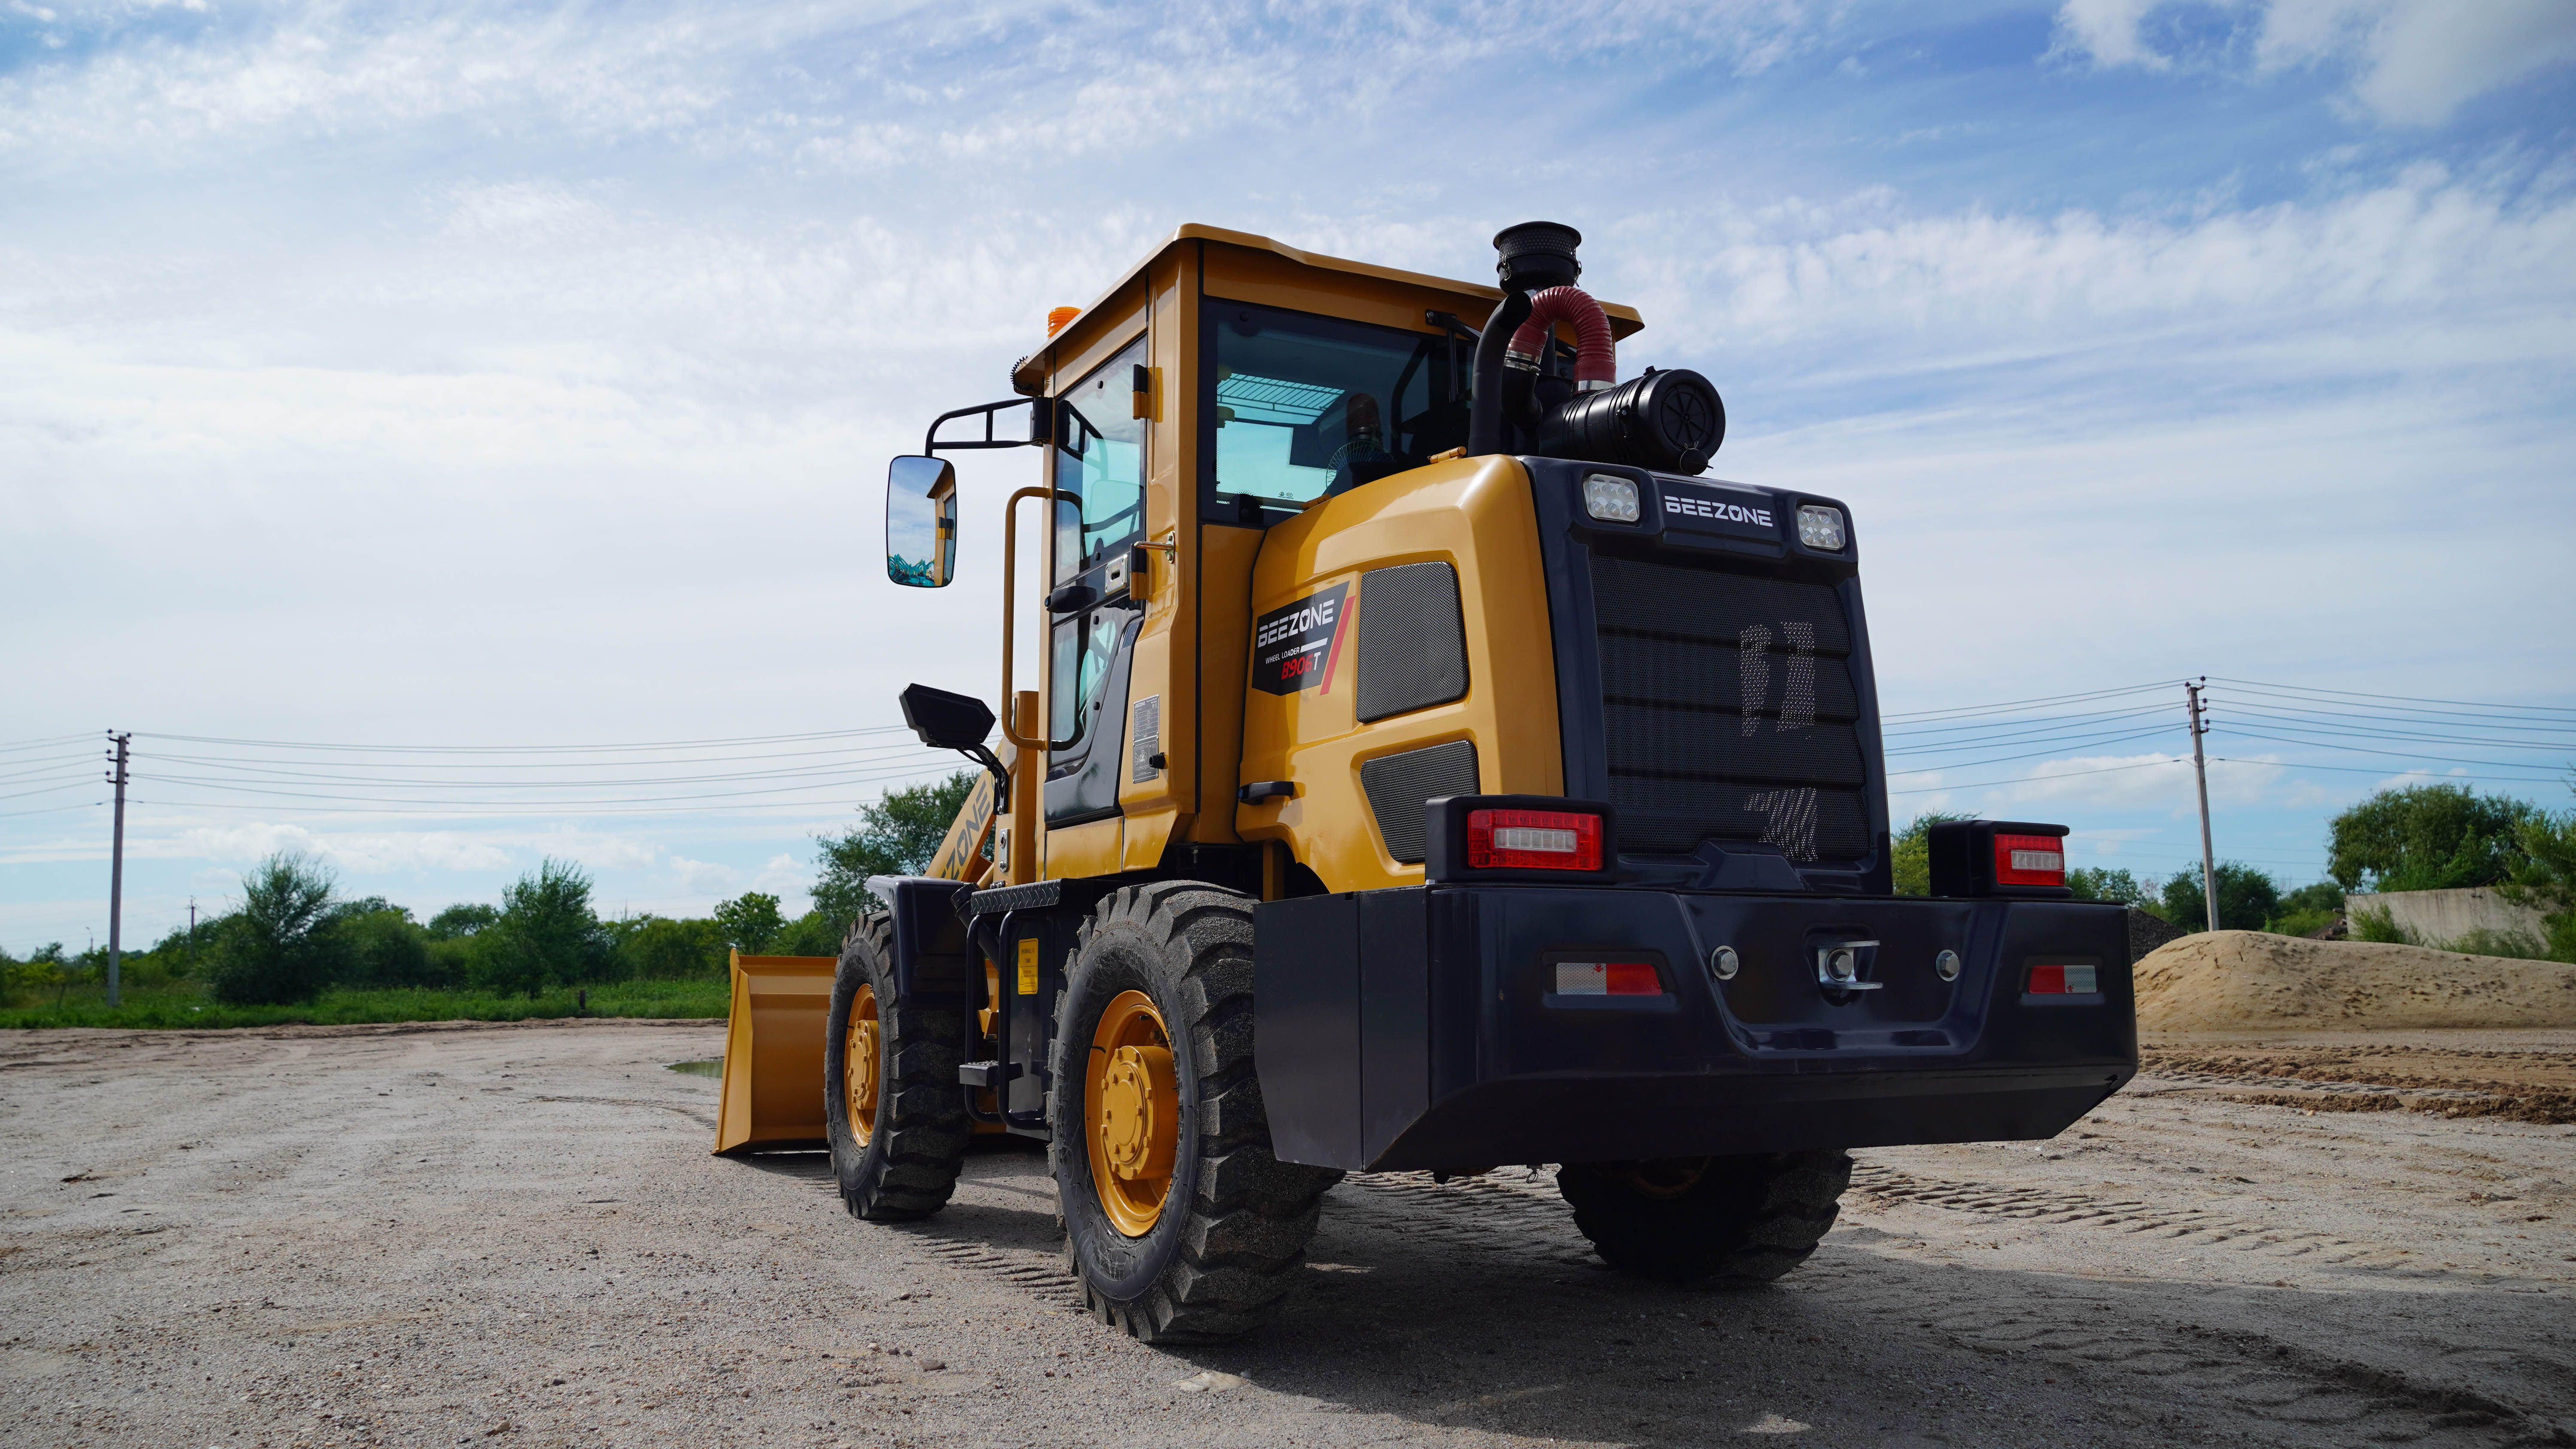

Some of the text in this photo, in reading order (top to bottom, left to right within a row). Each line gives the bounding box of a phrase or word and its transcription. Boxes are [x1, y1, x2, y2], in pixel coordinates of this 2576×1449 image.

[1665, 495, 1773, 527] BEEZONE
[1257, 599, 1334, 648] BEEZONE
[1265, 646, 1301, 664] WHEEL LOADER
[1281, 651, 1321, 680] B906T
